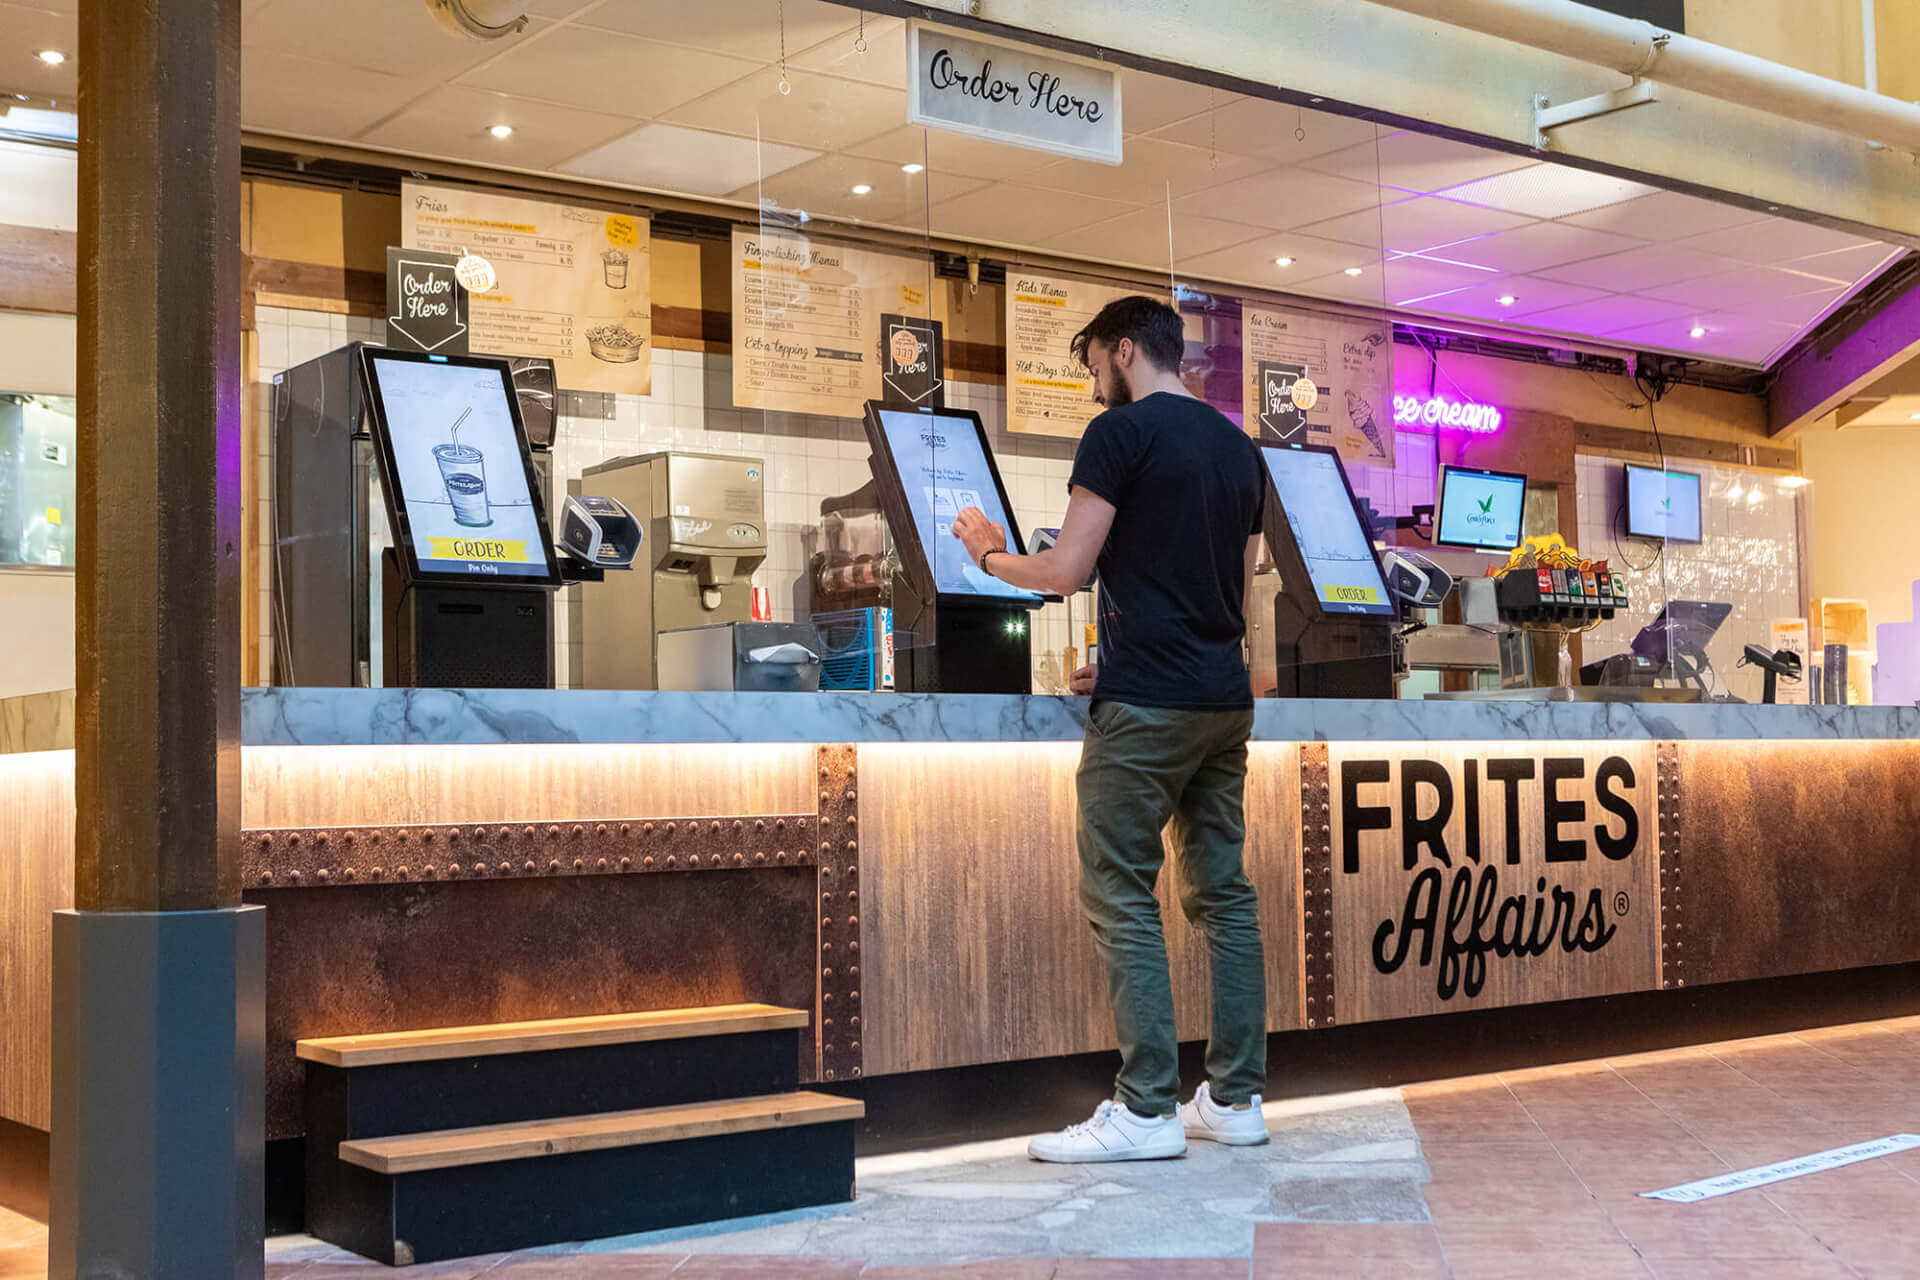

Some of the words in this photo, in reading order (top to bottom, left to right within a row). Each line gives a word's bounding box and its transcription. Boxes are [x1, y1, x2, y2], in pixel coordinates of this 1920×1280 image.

[930, 49, 1023, 106] Order
[1028, 71, 1103, 123] Here
[415, 194, 448, 212] Fries
[809, 249, 840, 267] Menus
[404, 271, 452, 296] Order
[1016, 279, 1037, 294] Kids
[1040, 282, 1068, 297] Menus
[406, 295, 449, 318] Here
[745, 335, 770, 350] Extra
[771, 339, 808, 360] topping
[1016, 359, 1032, 373] Hot
[1036, 361, 1057, 379] Dogs
[1270, 397, 1296, 415] Here
[1422, 396, 1501, 431] cream
[454, 541, 506, 558] ORDER
[1336, 587, 1368, 600] ORDER
[1341, 756, 1639, 874] FRITES
